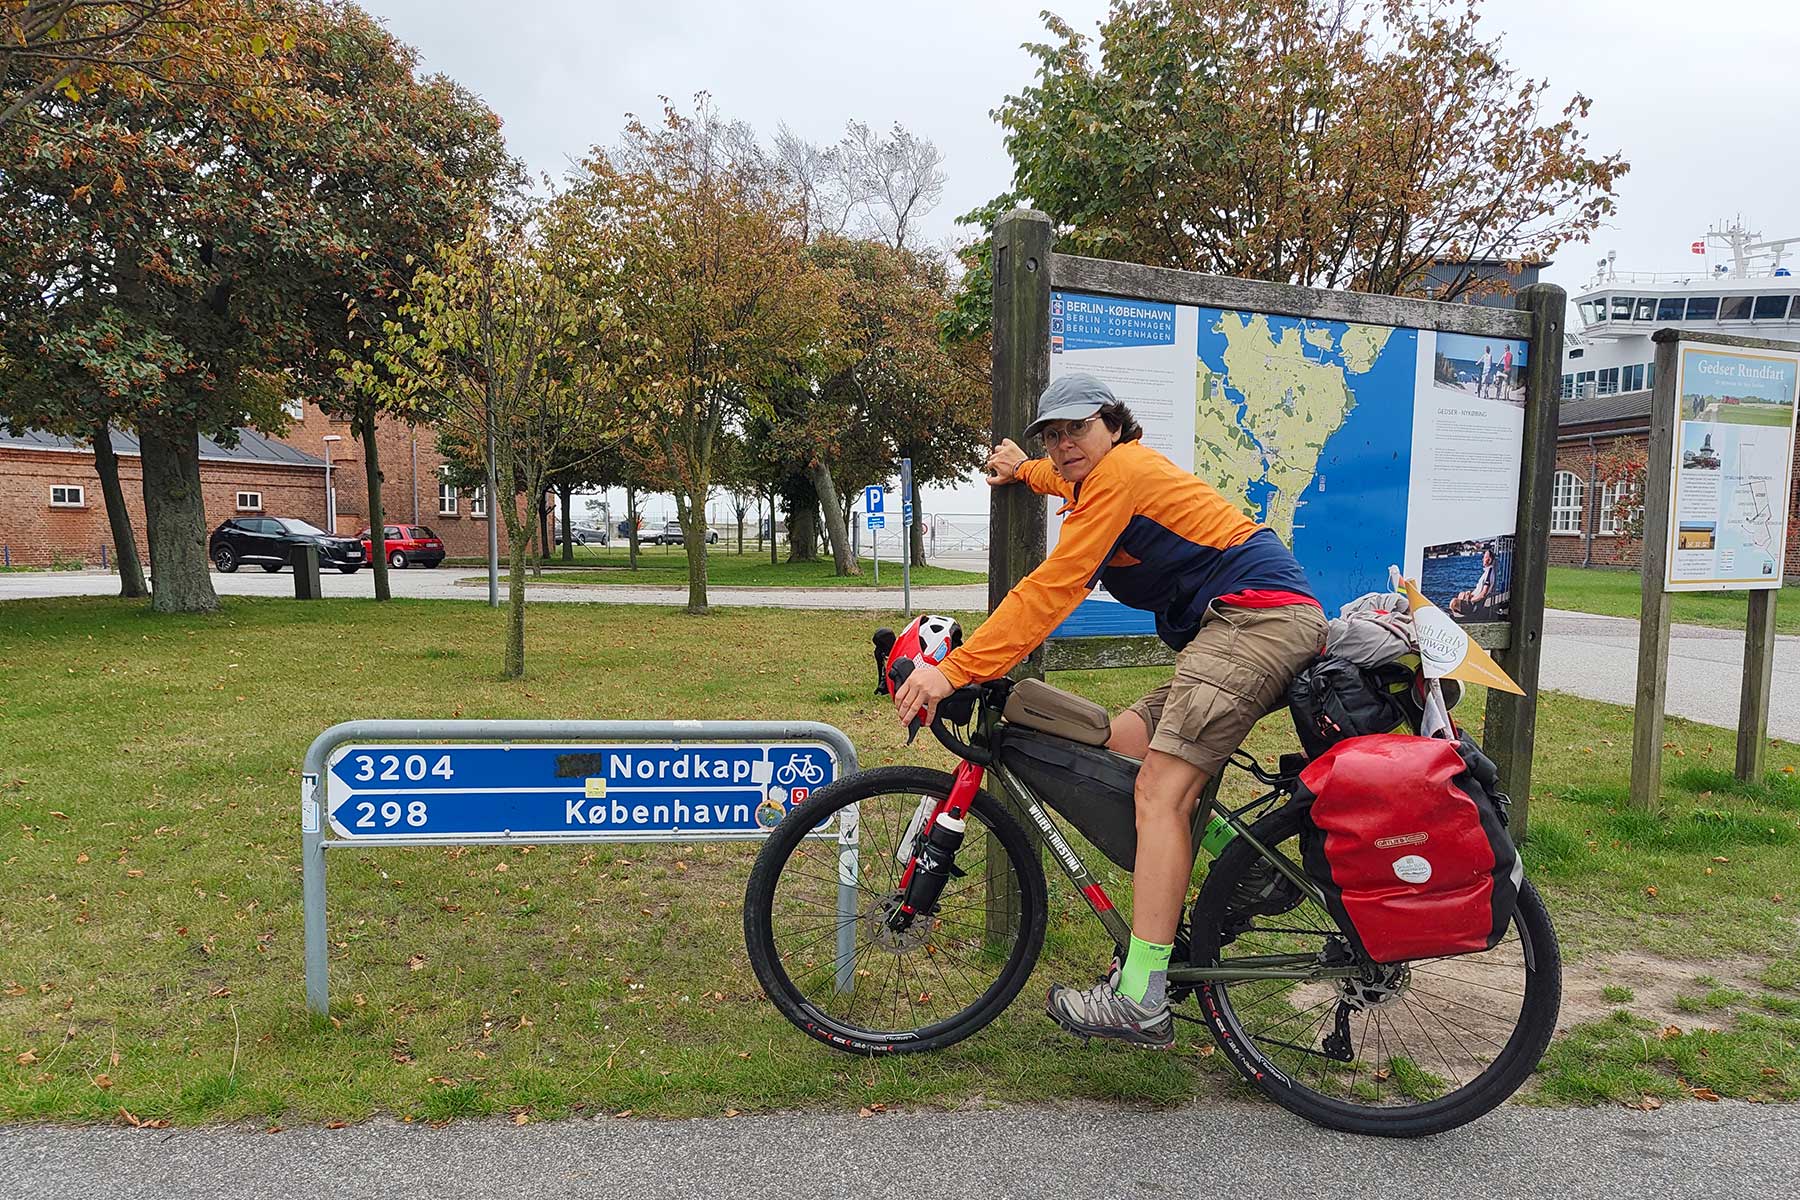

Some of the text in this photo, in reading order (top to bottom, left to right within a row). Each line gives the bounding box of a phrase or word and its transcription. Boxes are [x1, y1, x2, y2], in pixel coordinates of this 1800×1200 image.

[1066, 313, 1100, 324] BERLIN
[1108, 318, 1172, 331] KOPENHAGEN
[1066, 324, 1100, 335] BERLIN
[1108, 328, 1172, 341] COPENHAGEN
[1698, 360, 1784, 380] Gedser Rundfart
[870, 489, 881, 511] P
[1417, 636, 1457, 658] enways
[1437, 629, 1464, 648] Italy
[355, 754, 750, 786] 3204 Nordkap
[795, 790, 805, 800] 9
[356, 799, 749, 828] 298 København
[1028, 804, 1080, 872] WILIER TRIESTINA
